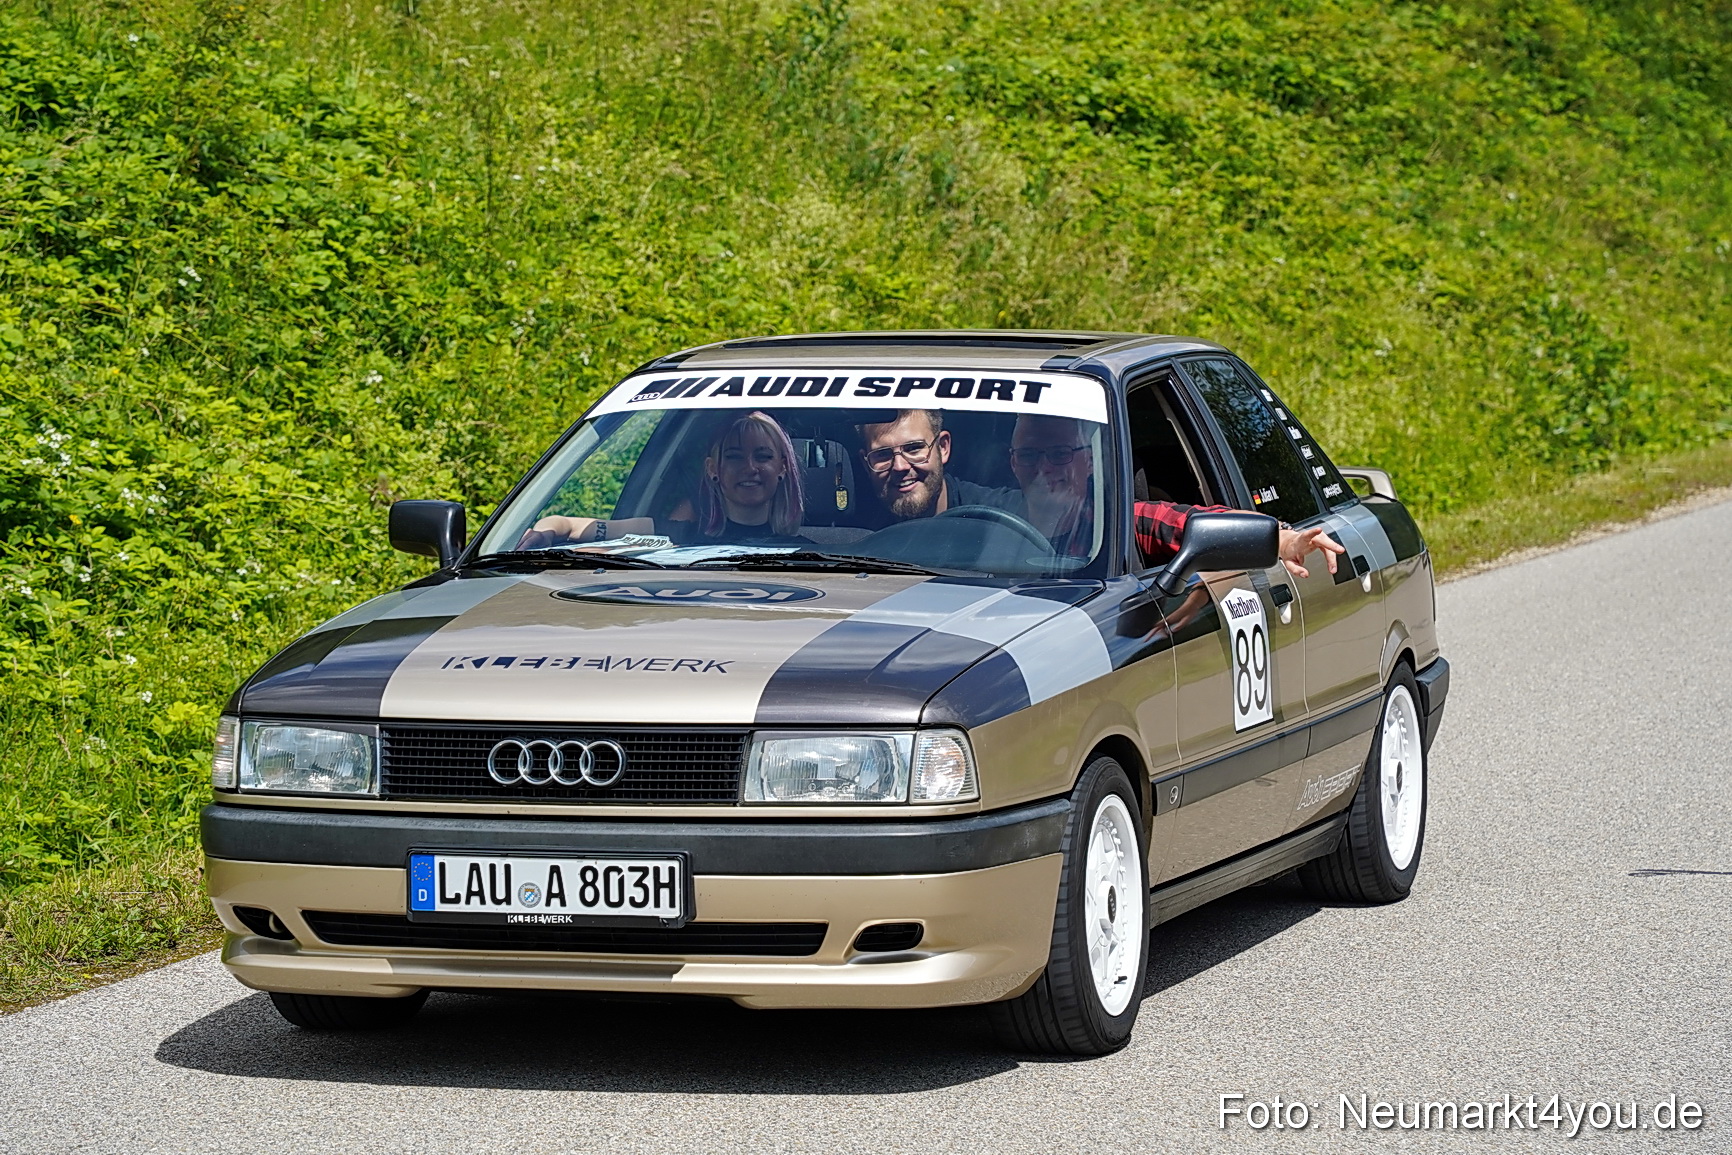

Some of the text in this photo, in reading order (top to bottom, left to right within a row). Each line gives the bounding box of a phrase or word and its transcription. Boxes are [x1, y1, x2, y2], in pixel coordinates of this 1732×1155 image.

[710, 376, 1052, 404] AUDI SPORT
[1225, 596, 1260, 620] Marlboro
[1235, 623, 1268, 717] 89
[418, 888, 428, 902] D
[438, 861, 676, 909] LAU A 803H
[507, 913, 573, 924] KLEBEWERK
